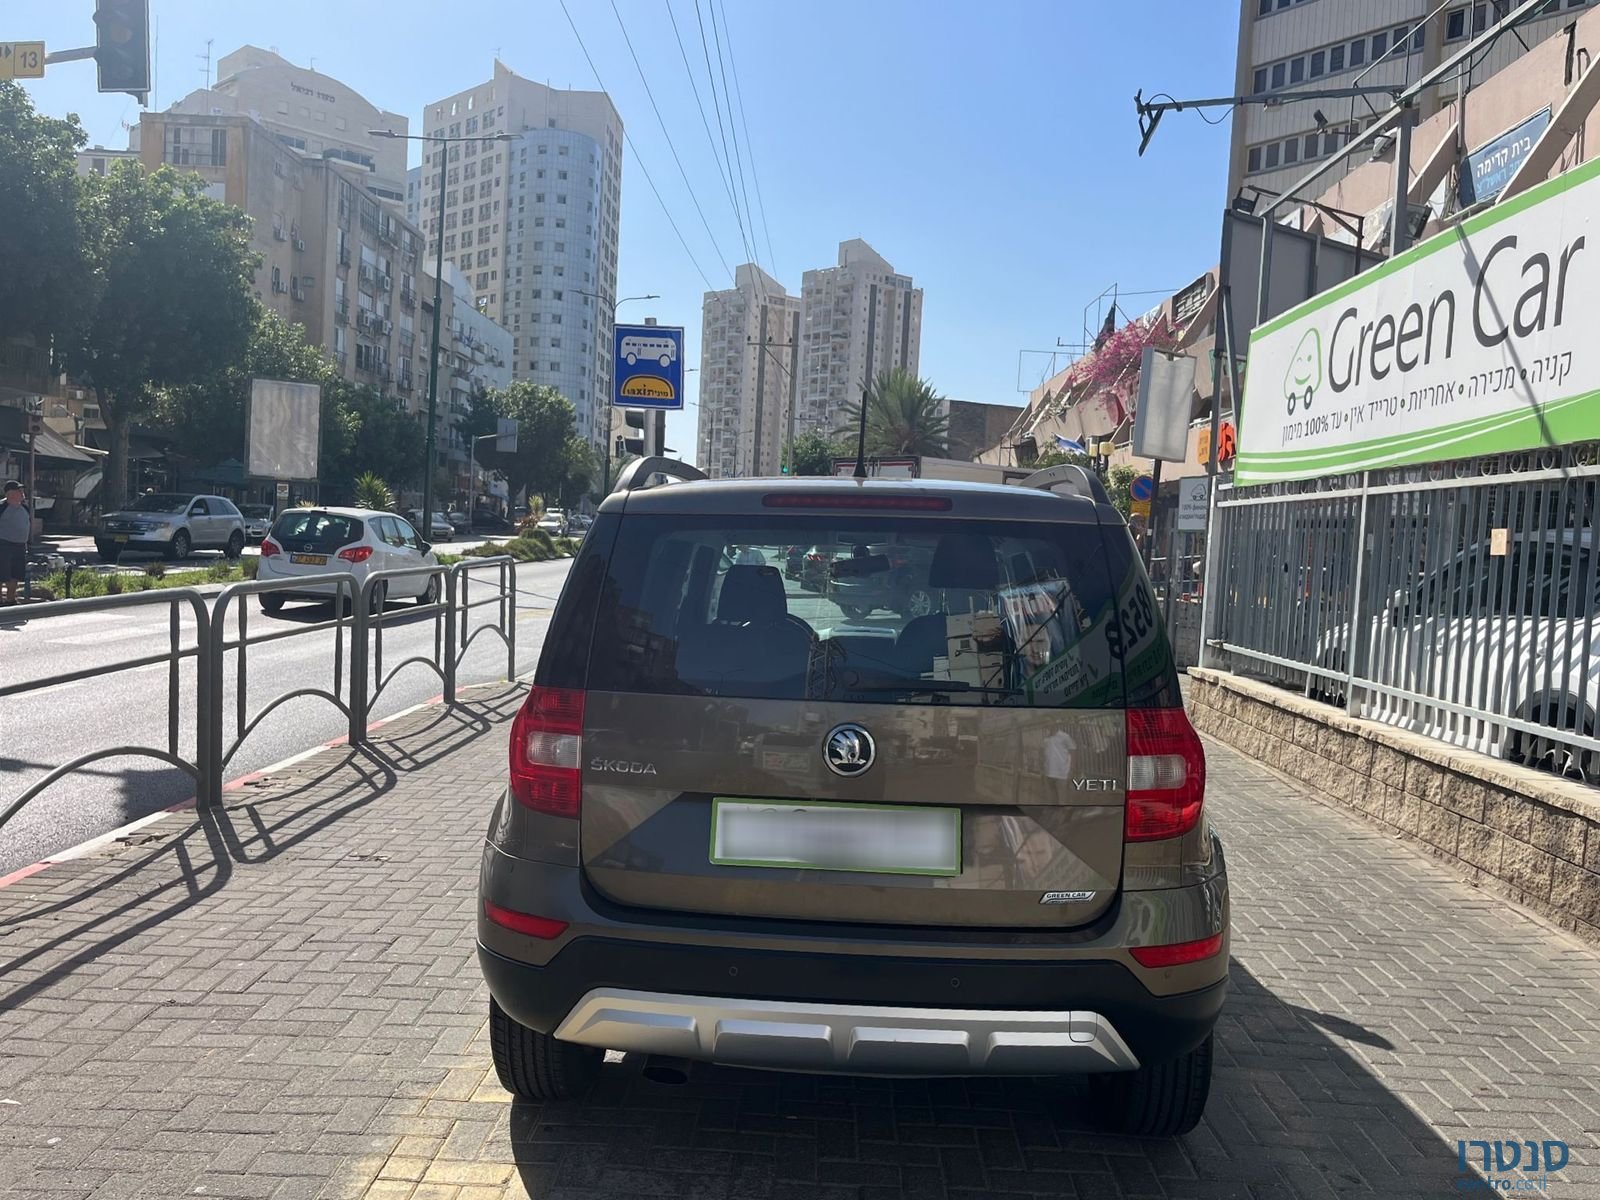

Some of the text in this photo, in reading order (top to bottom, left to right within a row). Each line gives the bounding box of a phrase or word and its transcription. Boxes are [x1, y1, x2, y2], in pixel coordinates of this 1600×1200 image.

[20, 51, 38, 69] 13
[1476, 136, 1531, 178] בית קדימה
[1328, 235, 1586, 393] Green Car
[1281, 351, 1573, 448] קניה מכירה אחריות טרייד אין עד 100% מימון
[590, 756, 657, 775] ŠKODA
[1072, 779, 1117, 791] YETI
